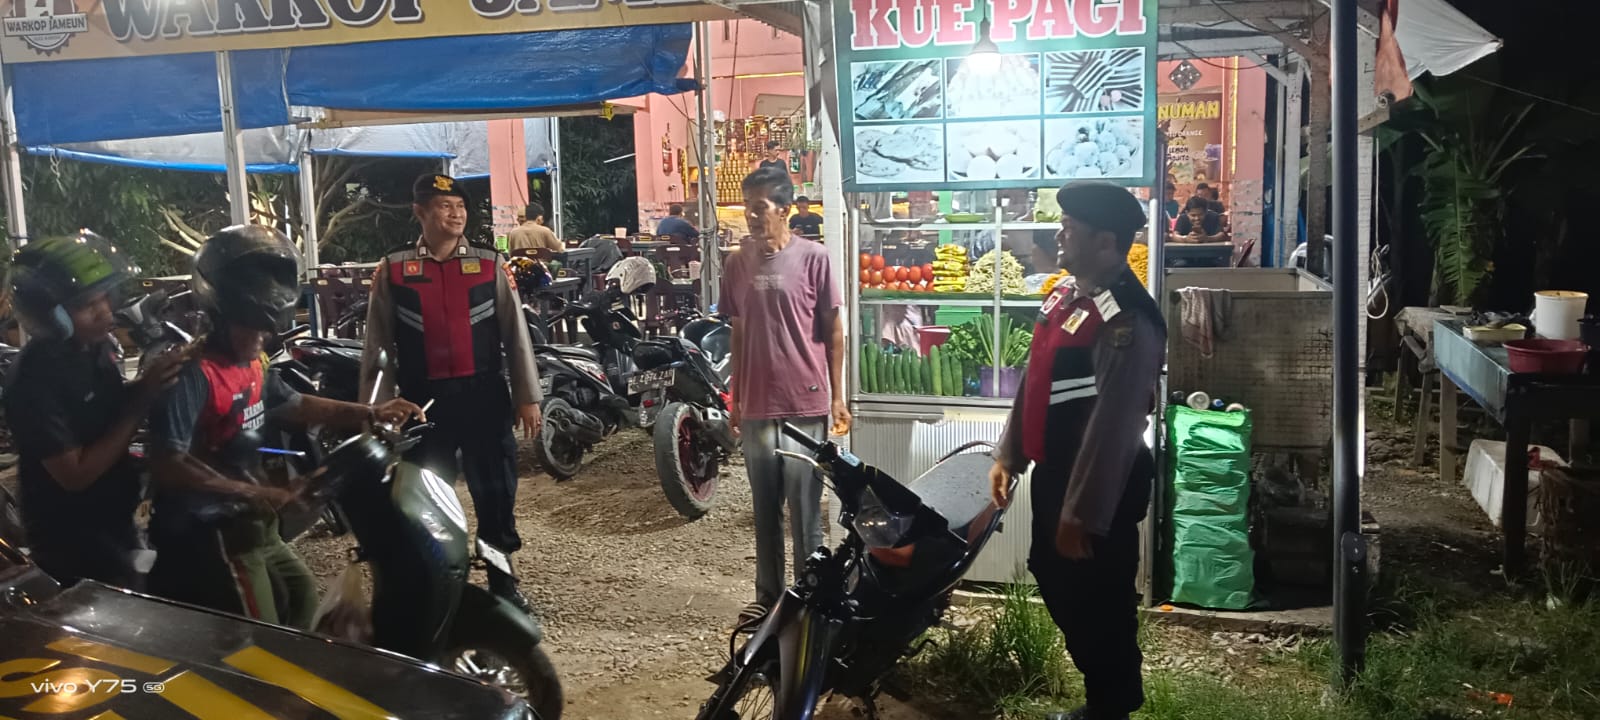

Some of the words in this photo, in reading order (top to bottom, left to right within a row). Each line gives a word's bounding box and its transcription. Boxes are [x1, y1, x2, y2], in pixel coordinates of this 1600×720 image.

[7, 20, 47, 32] WARKOP
[851, 0, 976, 50] KUE
[989, 0, 1147, 43] PAGI
